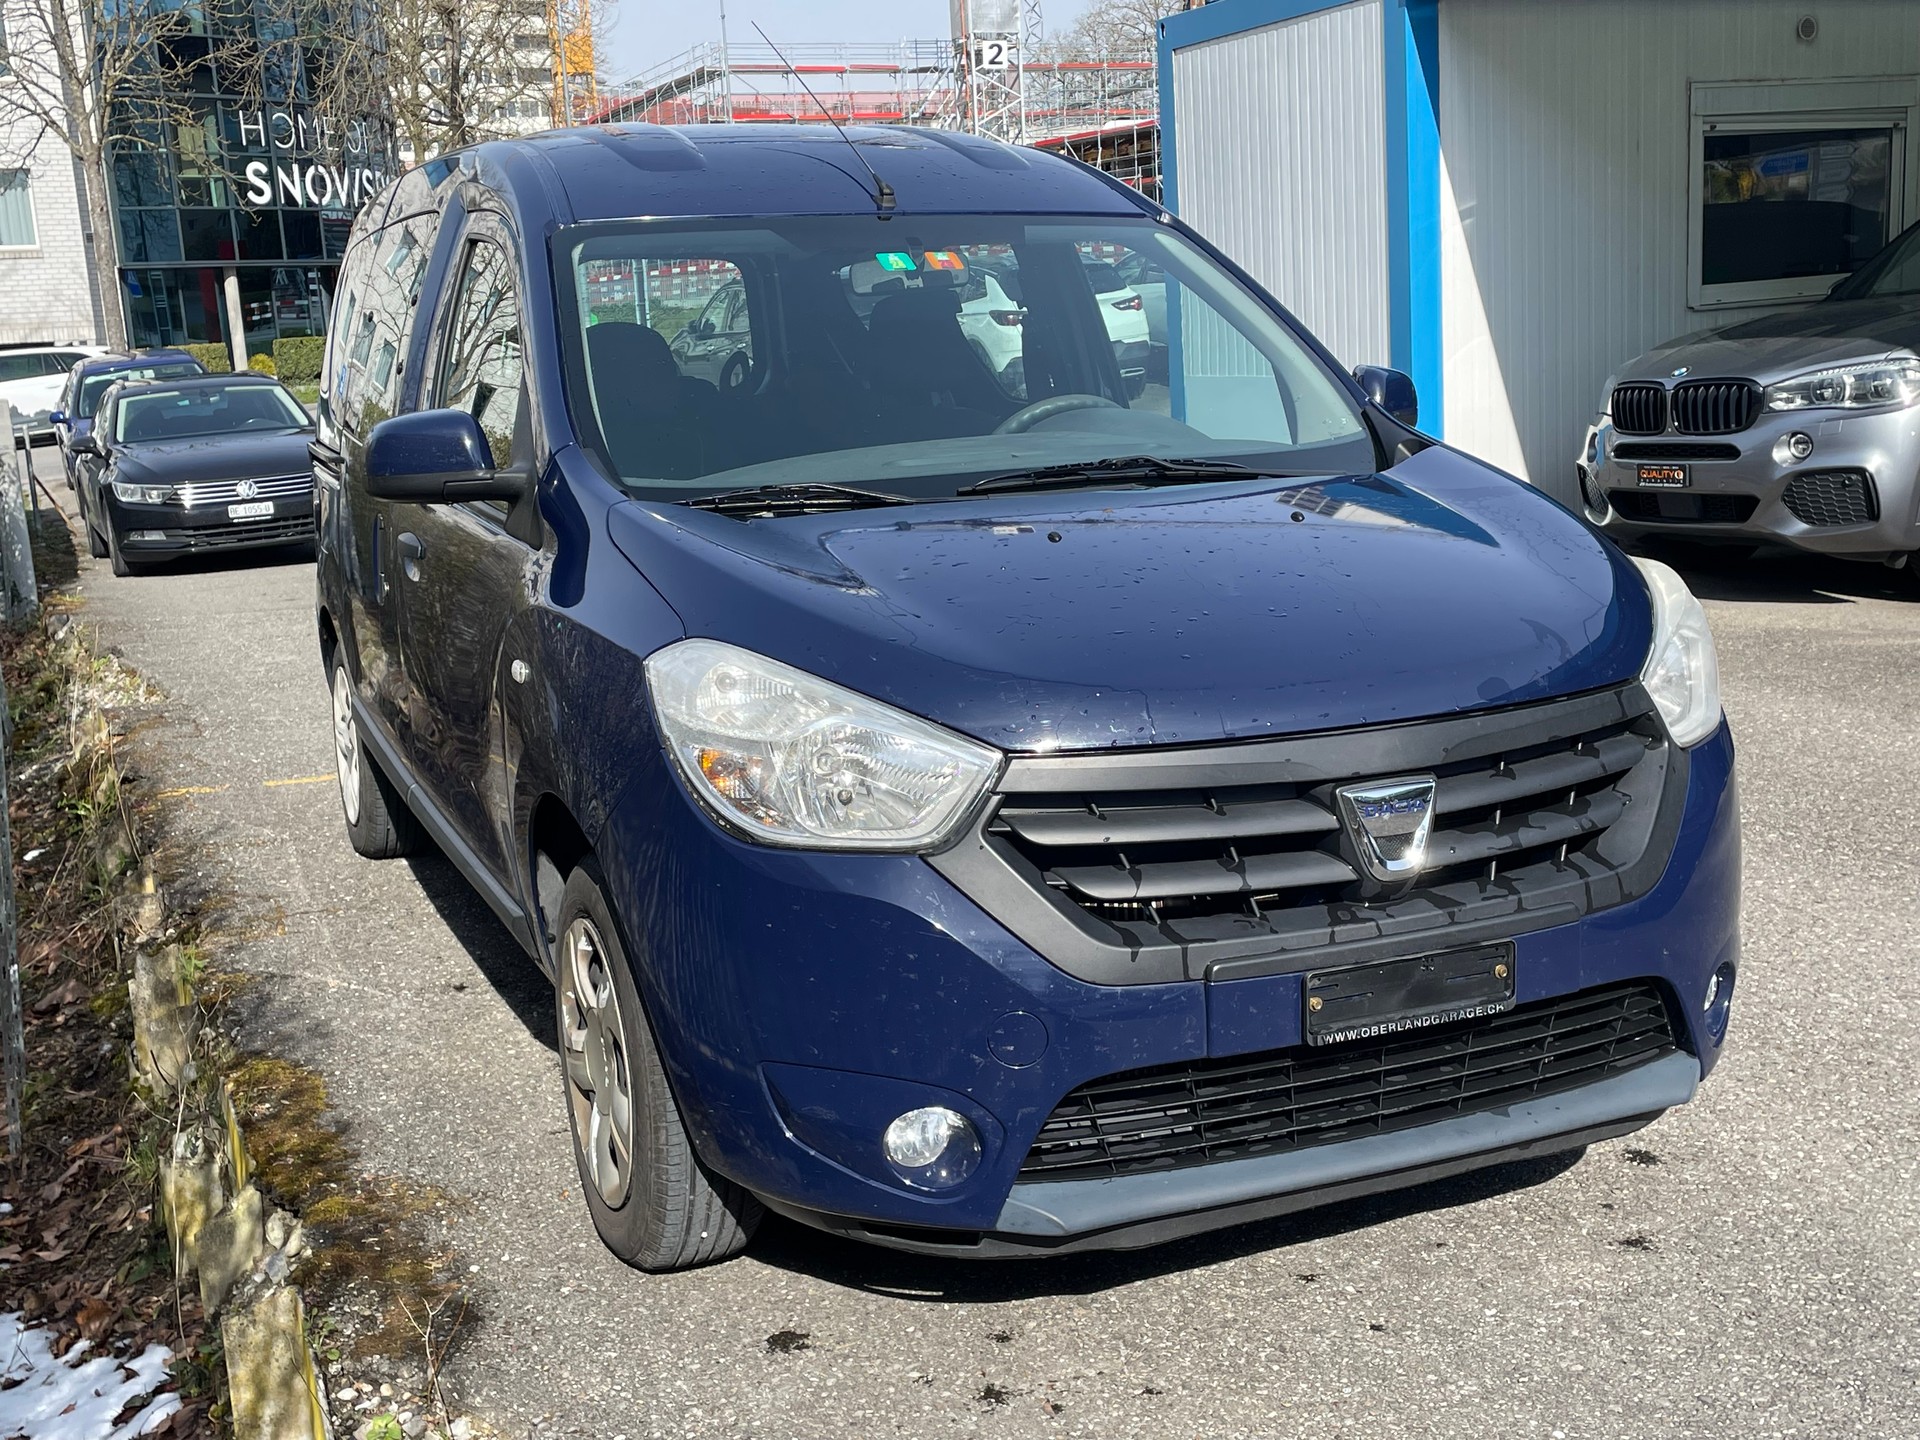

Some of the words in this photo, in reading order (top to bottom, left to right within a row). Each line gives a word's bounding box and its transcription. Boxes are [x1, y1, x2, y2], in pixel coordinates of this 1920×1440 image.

[988, 43, 1003, 65] 2
[239, 110, 339, 151] HOME
[1640, 469, 1674, 478] QUALITY
[1363, 799, 1426, 818] DACIA
